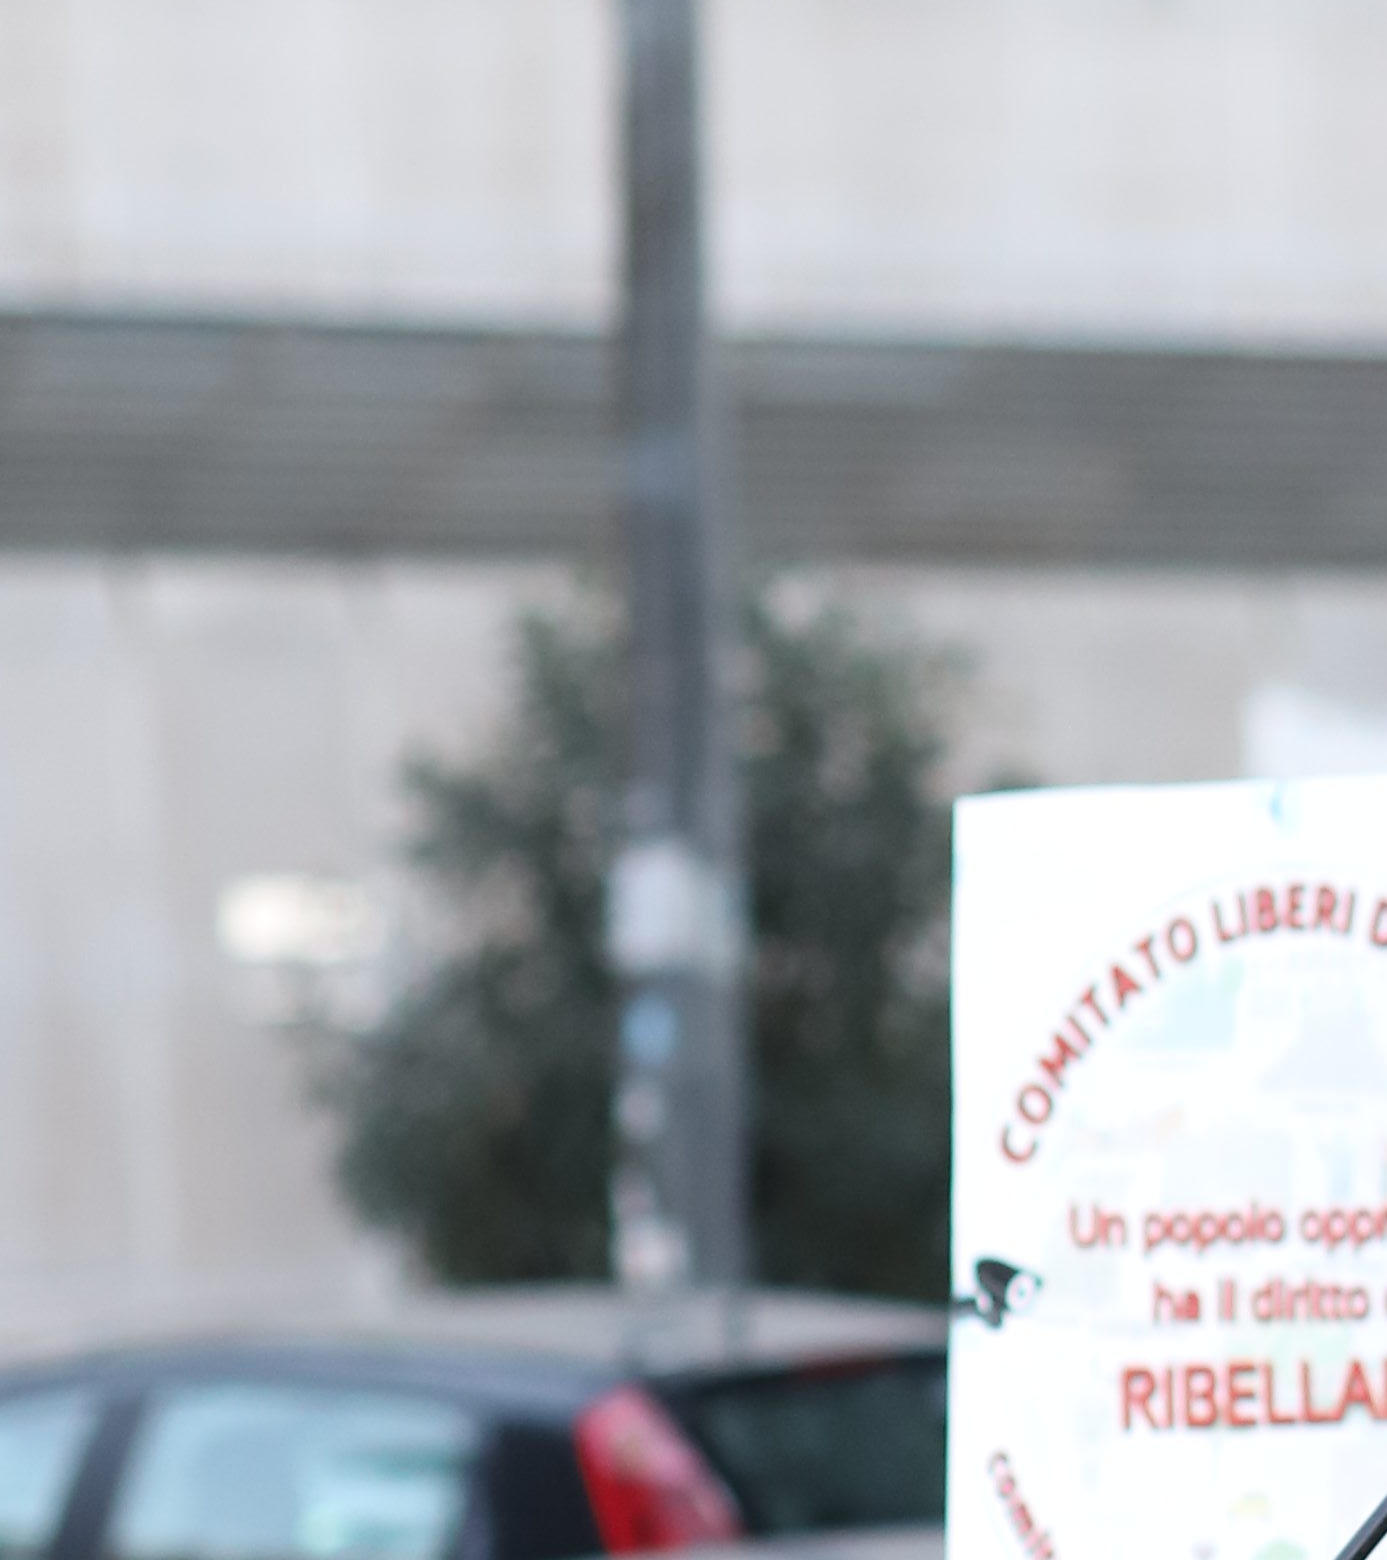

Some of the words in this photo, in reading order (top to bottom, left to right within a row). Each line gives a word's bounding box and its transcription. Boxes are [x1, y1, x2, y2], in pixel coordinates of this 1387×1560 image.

[1000, 915, 1198, 1164] COMITATO
[1211, 881, 1355, 943] LIBERI
[1069, 1203, 1126, 1248] Un
[1143, 1203, 1285, 1256] popolo
[1152, 1277, 1202, 1323] ha
[1219, 1277, 1236, 1321] il
[1251, 1276, 1369, 1323] diritto
